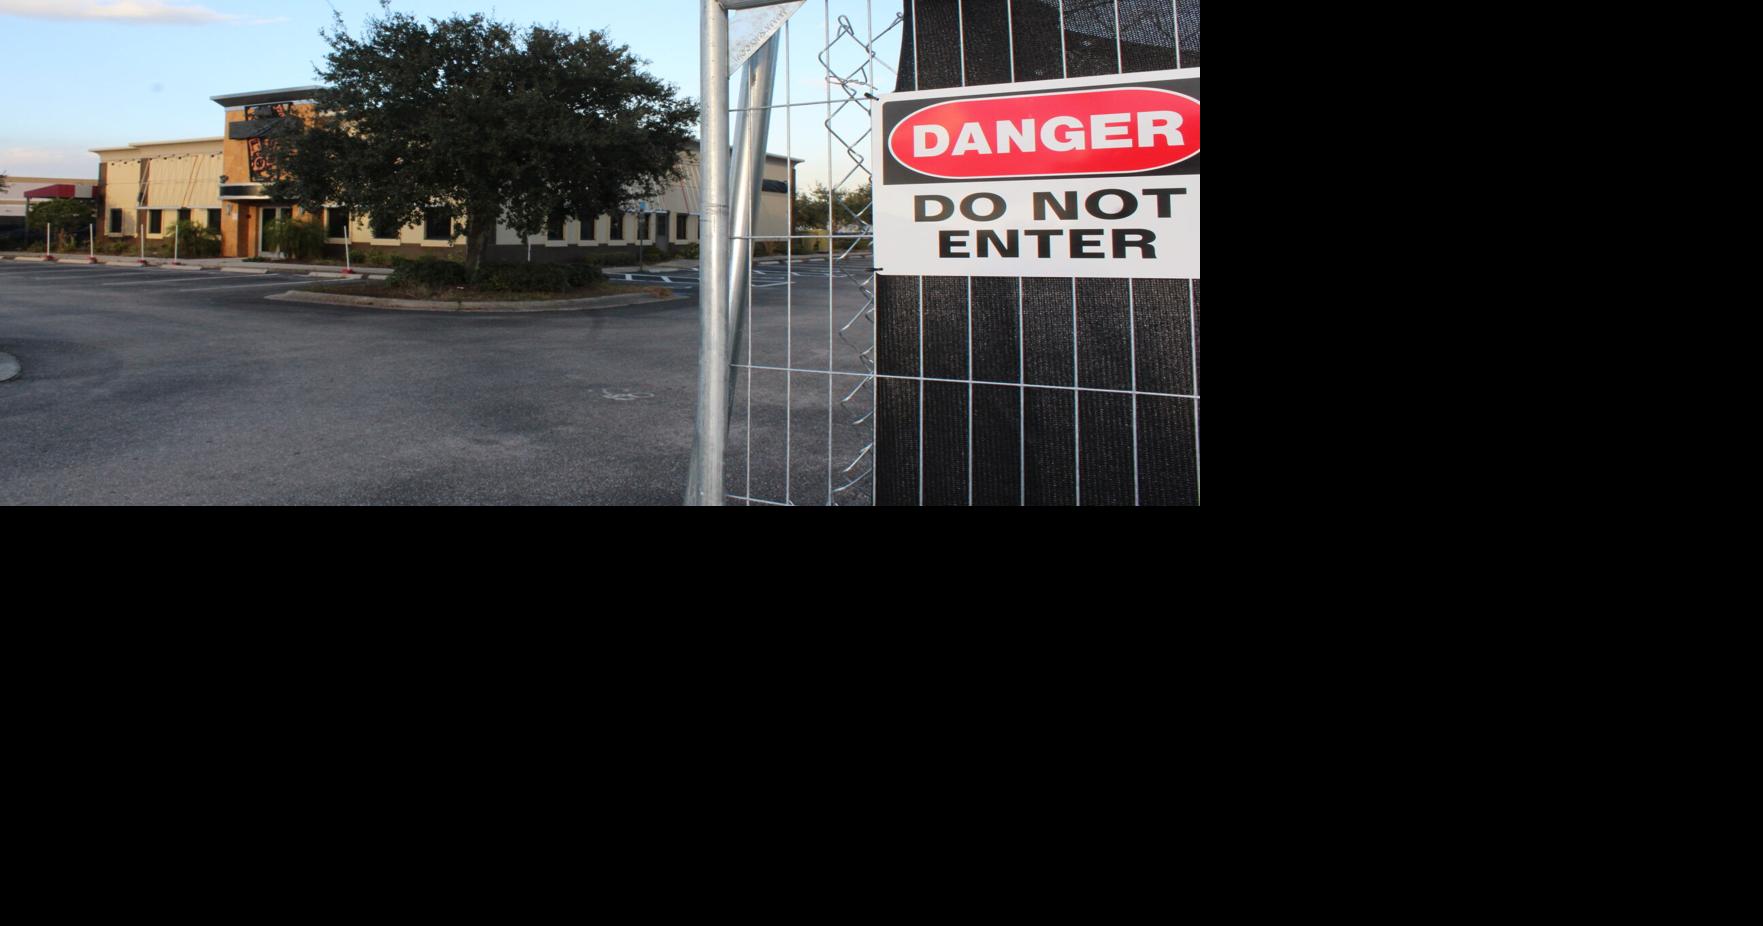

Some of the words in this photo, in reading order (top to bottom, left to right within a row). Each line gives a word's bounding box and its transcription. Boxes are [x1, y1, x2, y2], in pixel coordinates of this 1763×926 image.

[913, 110, 1185, 158] DANGER
[913, 192, 1007, 222] DO
[1032, 187, 1187, 221] NOT
[938, 228, 1157, 259] ENTER
